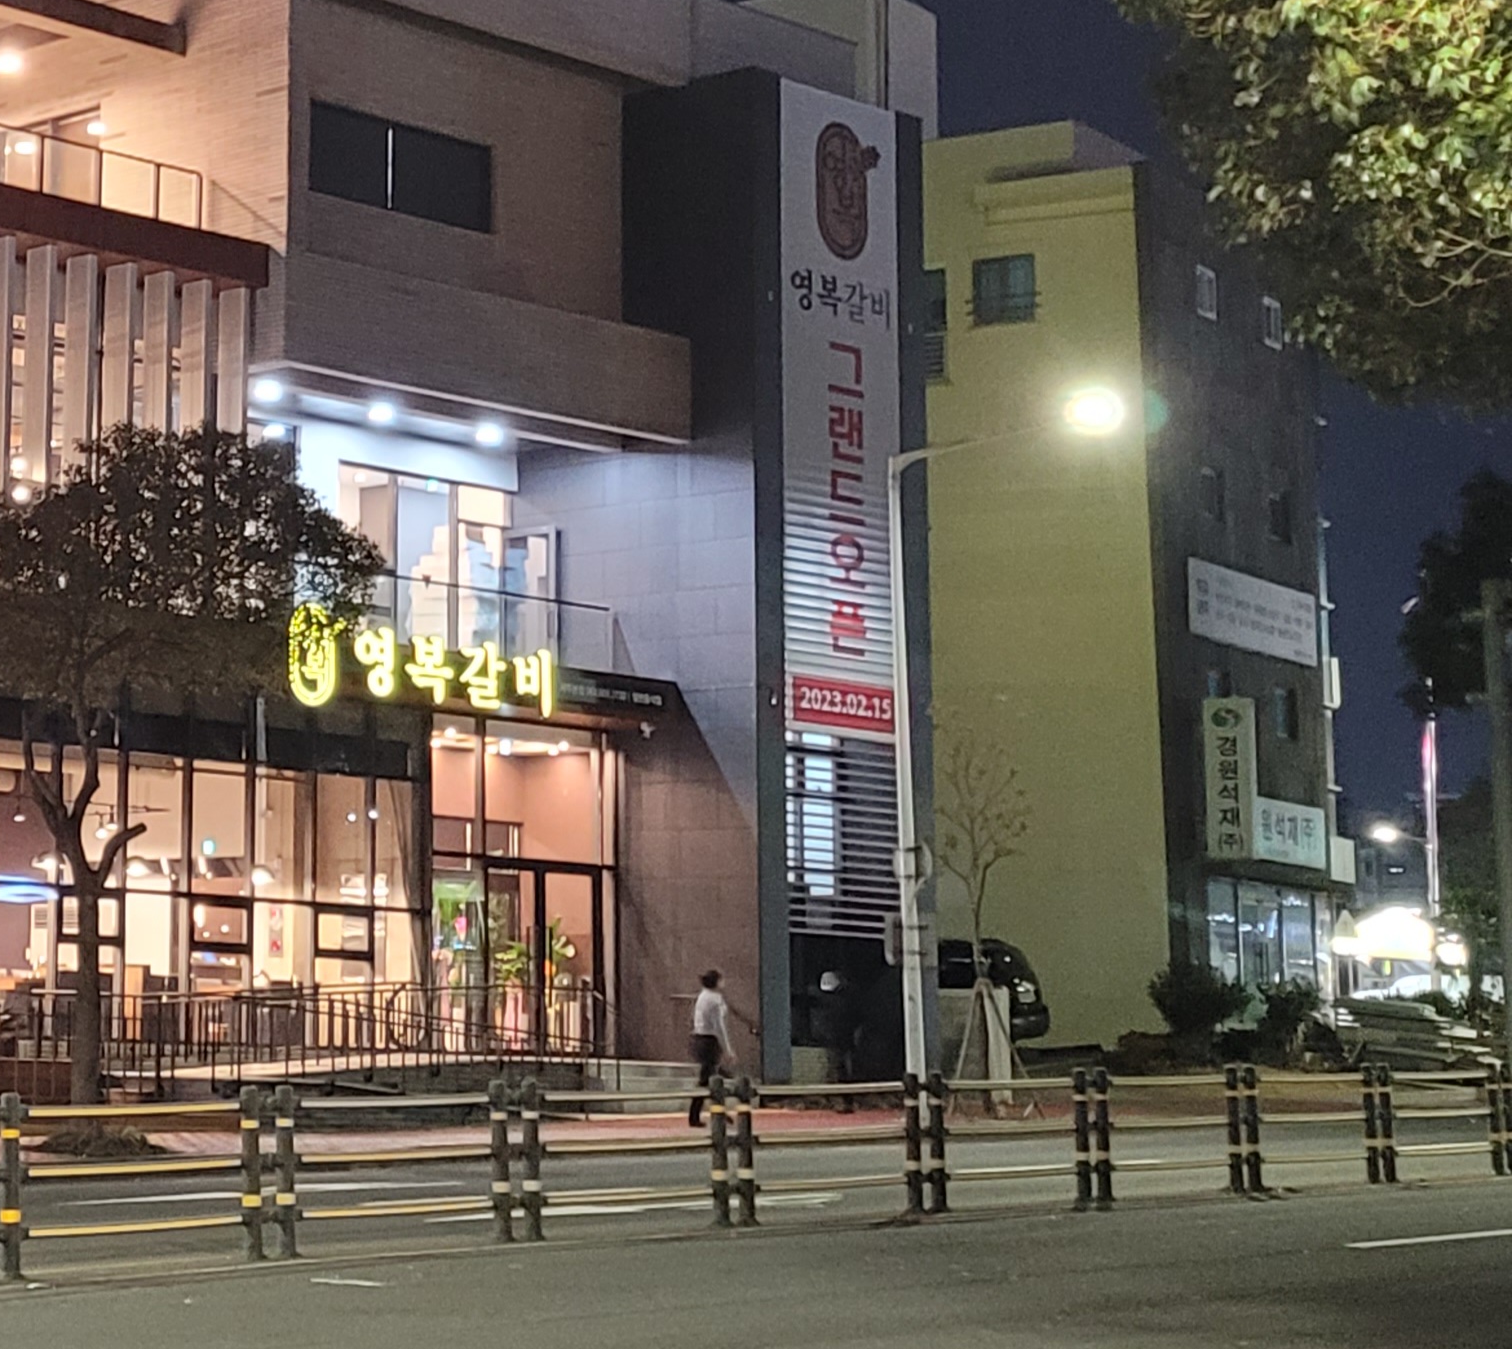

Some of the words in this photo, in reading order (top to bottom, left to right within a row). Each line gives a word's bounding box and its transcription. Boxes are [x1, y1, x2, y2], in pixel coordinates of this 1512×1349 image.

[790, 269, 890, 330] 영복갈비
[353, 627, 553, 719] 영복갈비
[800, 686, 892, 720] 2023.02.15
